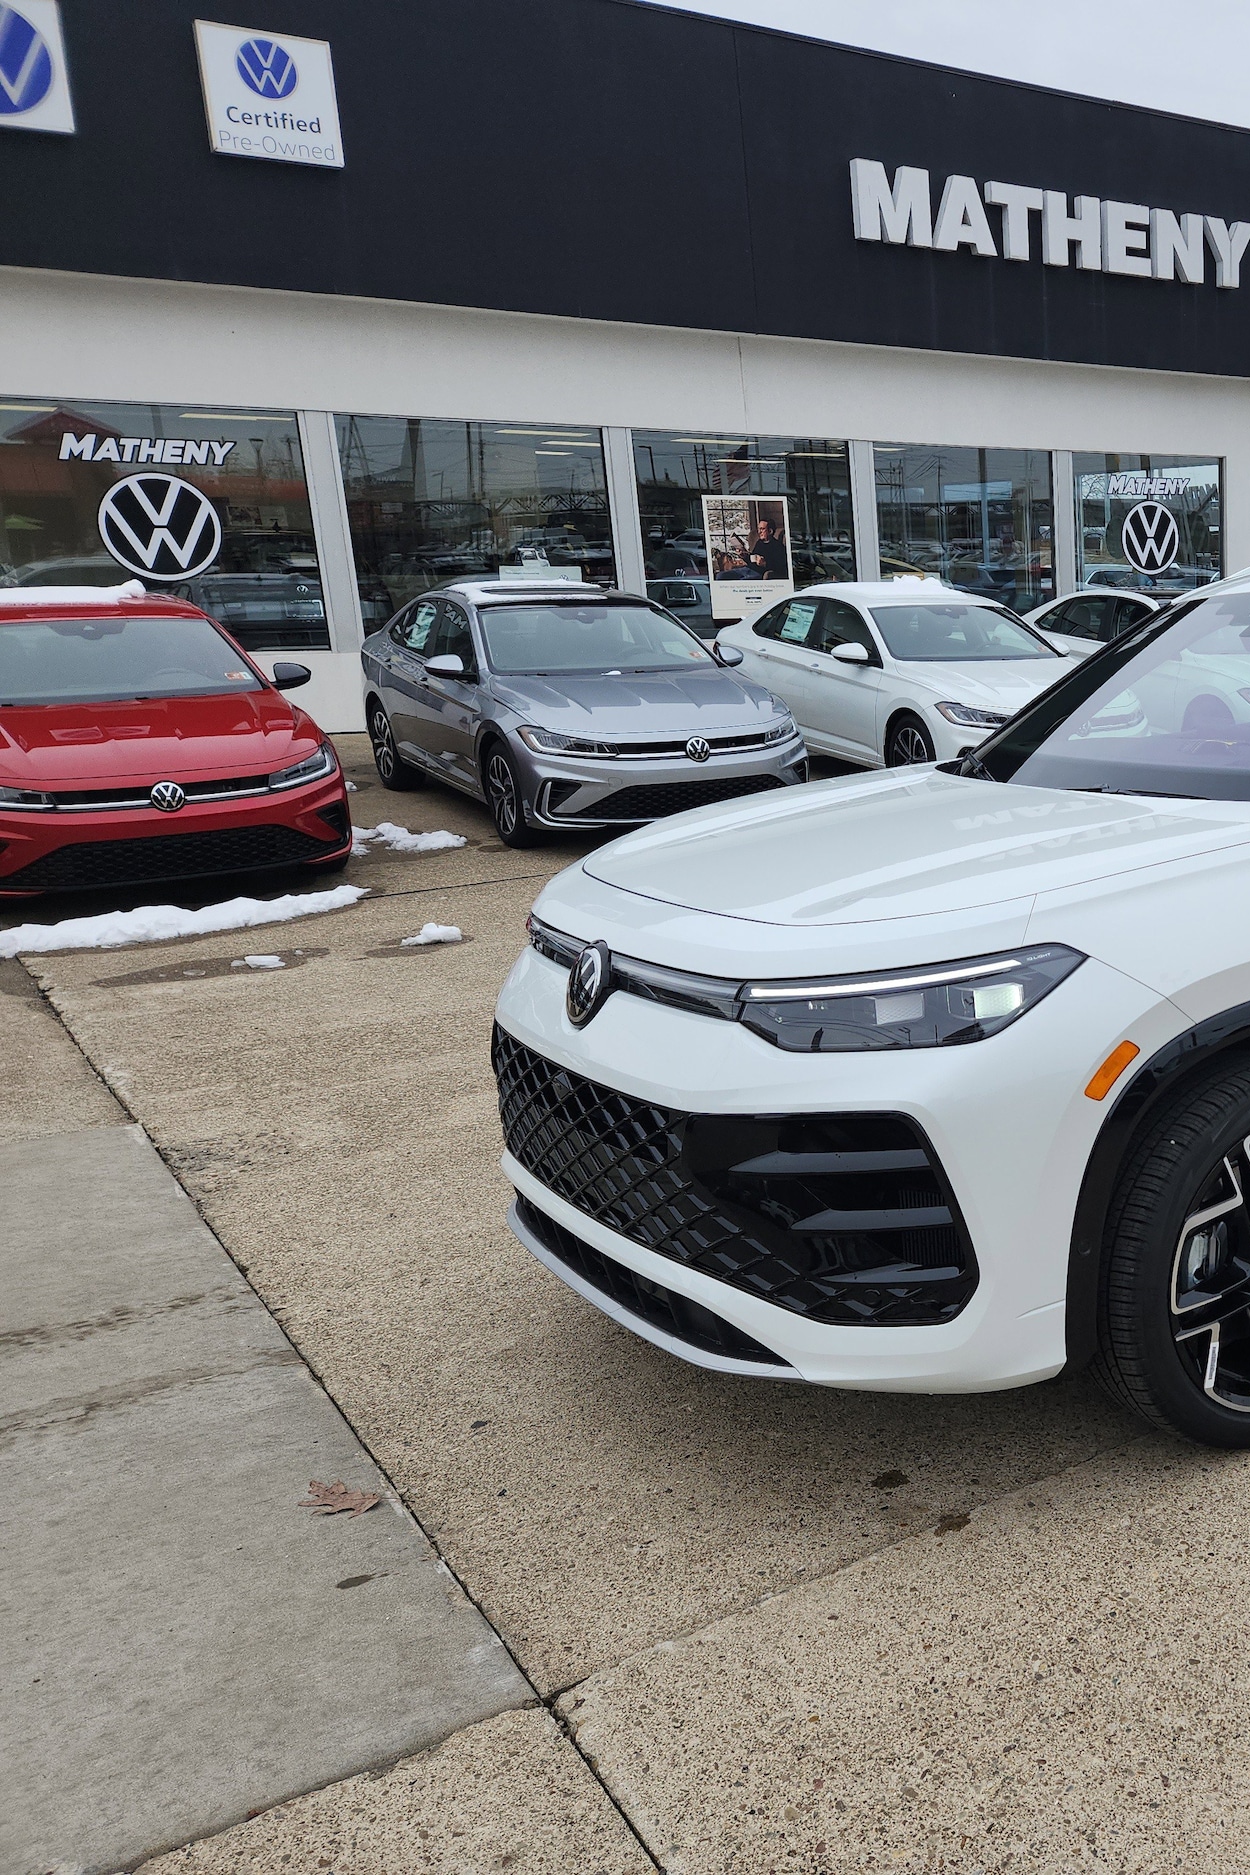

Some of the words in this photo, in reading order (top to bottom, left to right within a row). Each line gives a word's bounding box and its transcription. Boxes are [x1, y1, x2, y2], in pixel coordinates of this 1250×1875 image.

[226, 106, 321, 134] Certified
[218, 130, 336, 161] Pre-Owned
[58, 432, 237, 465] MATHENY
[1107, 475, 1190, 495] MATHENY
